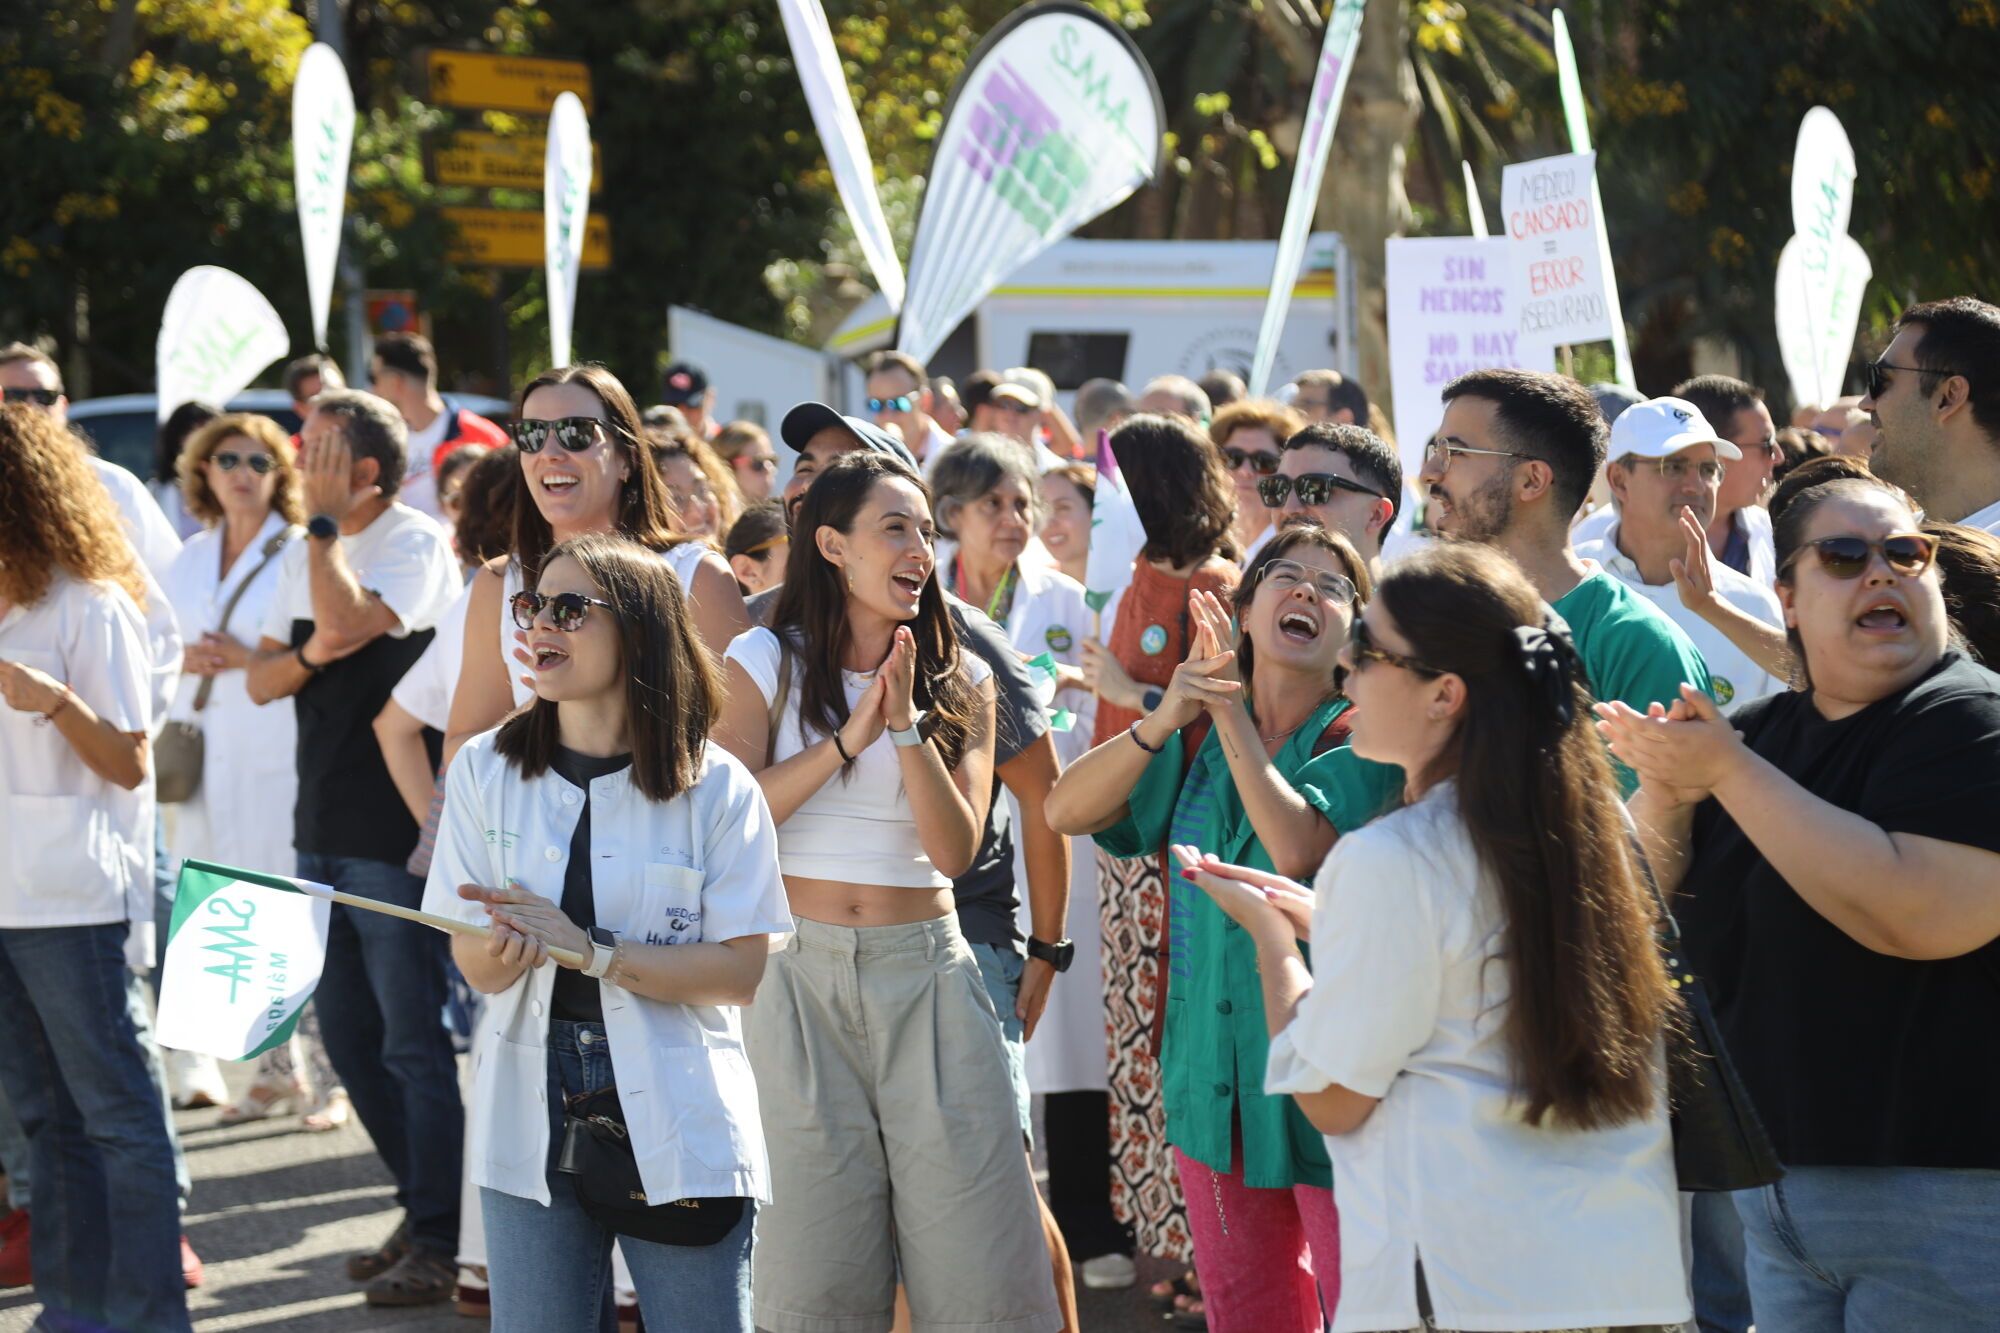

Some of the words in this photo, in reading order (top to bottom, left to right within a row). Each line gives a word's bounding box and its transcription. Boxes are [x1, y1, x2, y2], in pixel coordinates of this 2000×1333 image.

[1510, 199, 1590, 241] CANSADO
[1443, 257, 1486, 282] SIN
[1529, 256, 1585, 297] ERROR
[1519, 291, 1604, 335] ASEGURADO
[1428, 332, 1458, 356] NO
[1472, 328, 1519, 356] HAY
[1168, 752, 1216, 980] QUIRFANO
